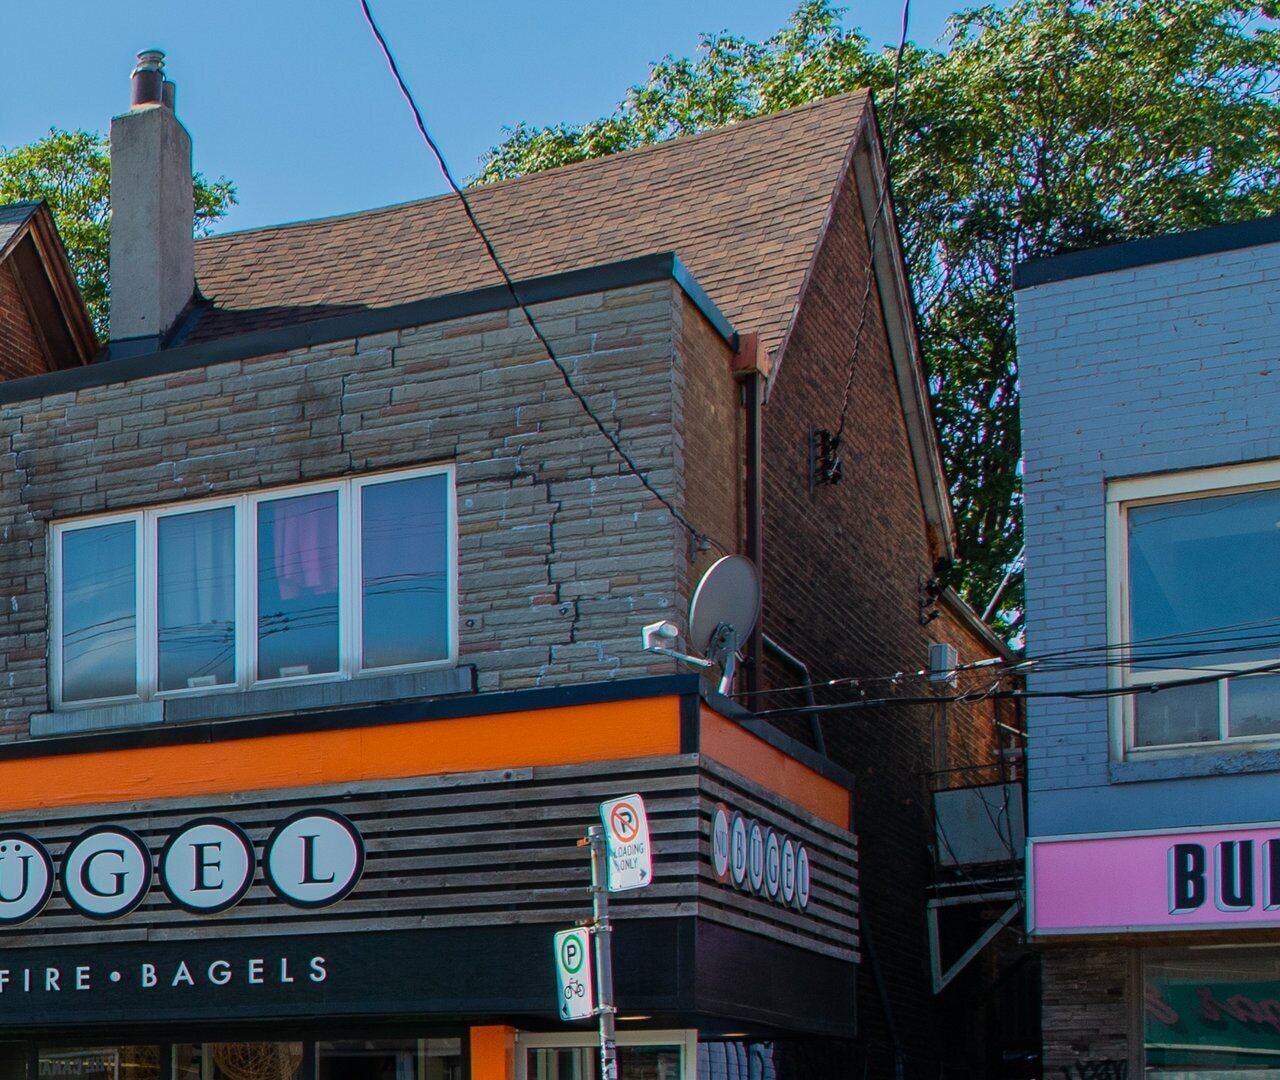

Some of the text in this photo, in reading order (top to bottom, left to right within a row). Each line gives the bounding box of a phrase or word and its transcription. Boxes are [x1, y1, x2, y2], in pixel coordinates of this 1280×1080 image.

[613, 842, 644, 859] LOADING
[618, 857, 639, 871] ONLY
[736, 830, 808, 896] BÜGEL
[142, 956, 328, 988] BAGELS
